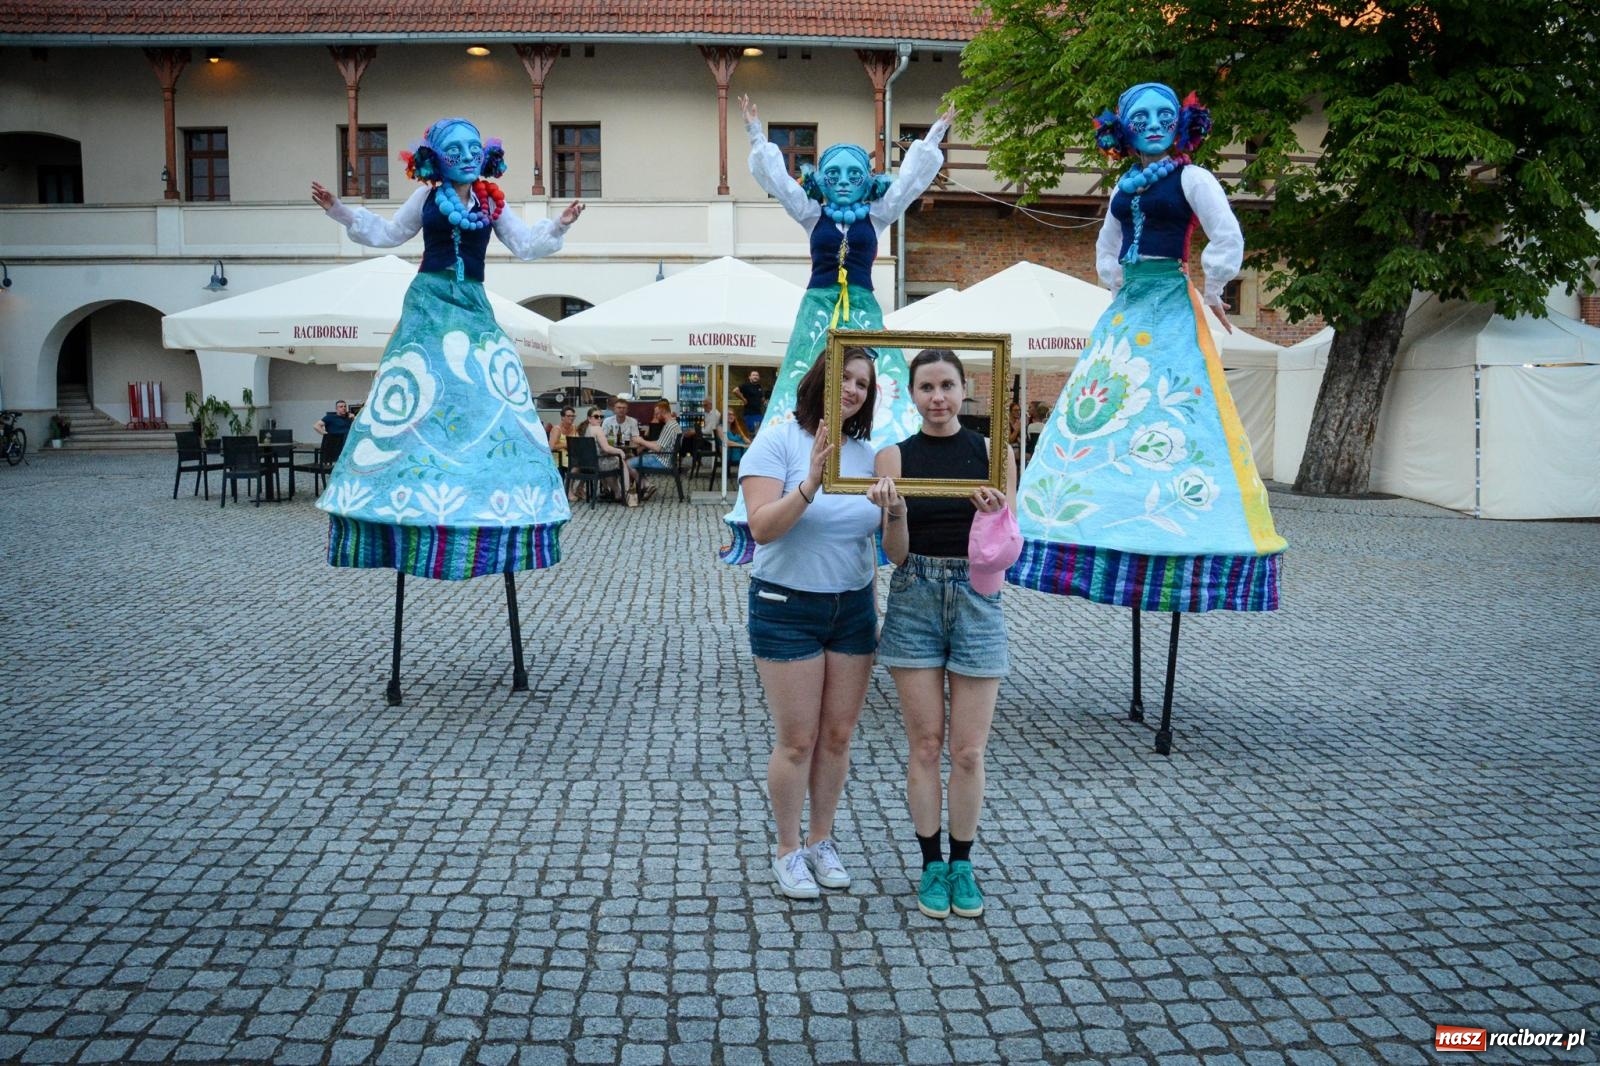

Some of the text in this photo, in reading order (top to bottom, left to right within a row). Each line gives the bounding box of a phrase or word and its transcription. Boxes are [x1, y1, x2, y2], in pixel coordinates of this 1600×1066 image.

[294, 325, 359, 339] RACIBORSKIE
[688, 333, 757, 348] RACIBORSKIE
[1028, 337, 1089, 350] RACIBORSKI
